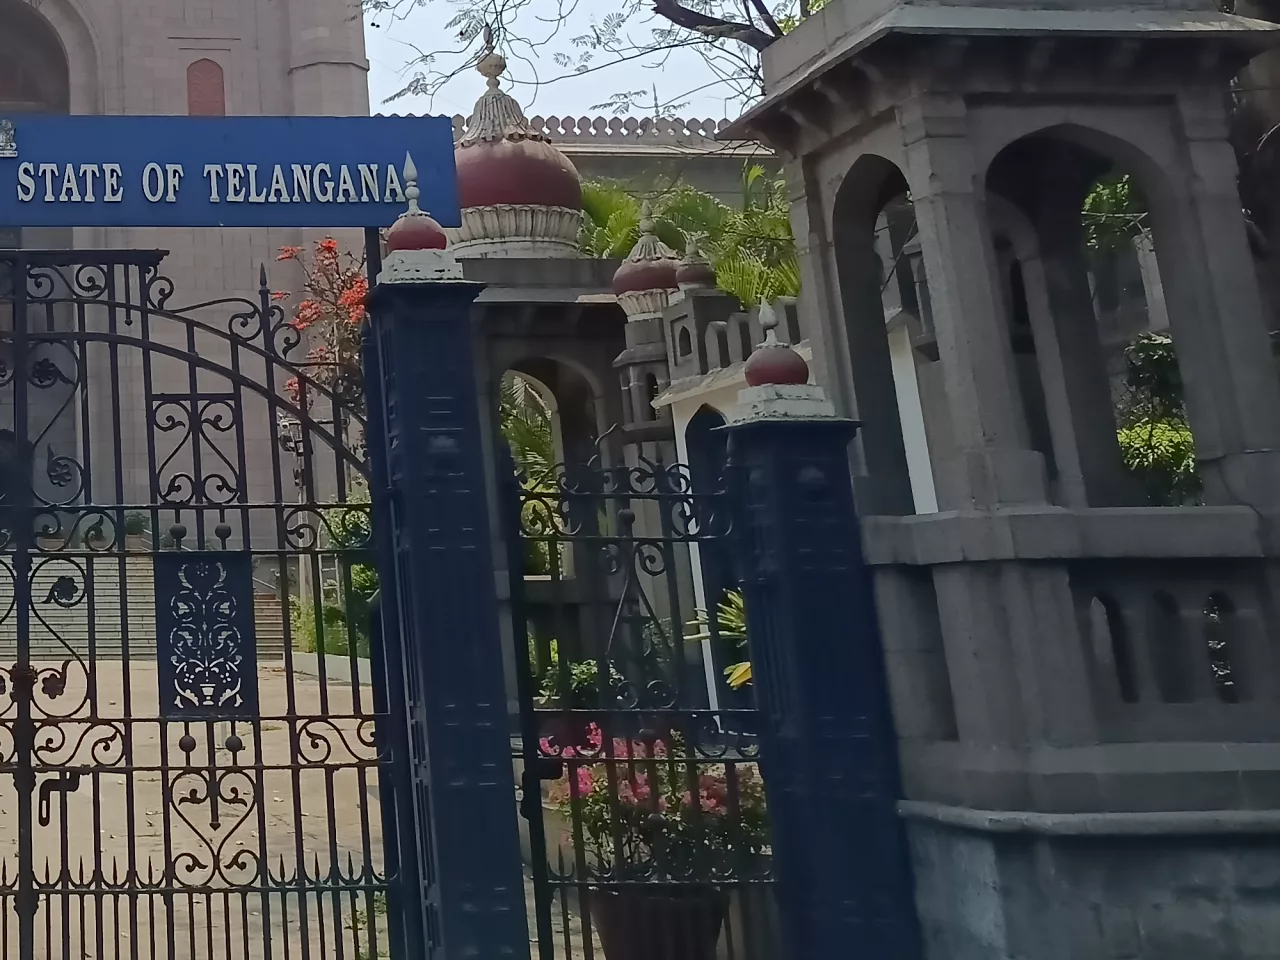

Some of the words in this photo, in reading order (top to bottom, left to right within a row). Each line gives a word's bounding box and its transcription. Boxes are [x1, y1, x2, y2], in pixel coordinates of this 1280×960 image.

[18, 161, 123, 202] STATE
[142, 161, 185, 203] OF
[203, 162, 406, 203] TELANGANA
